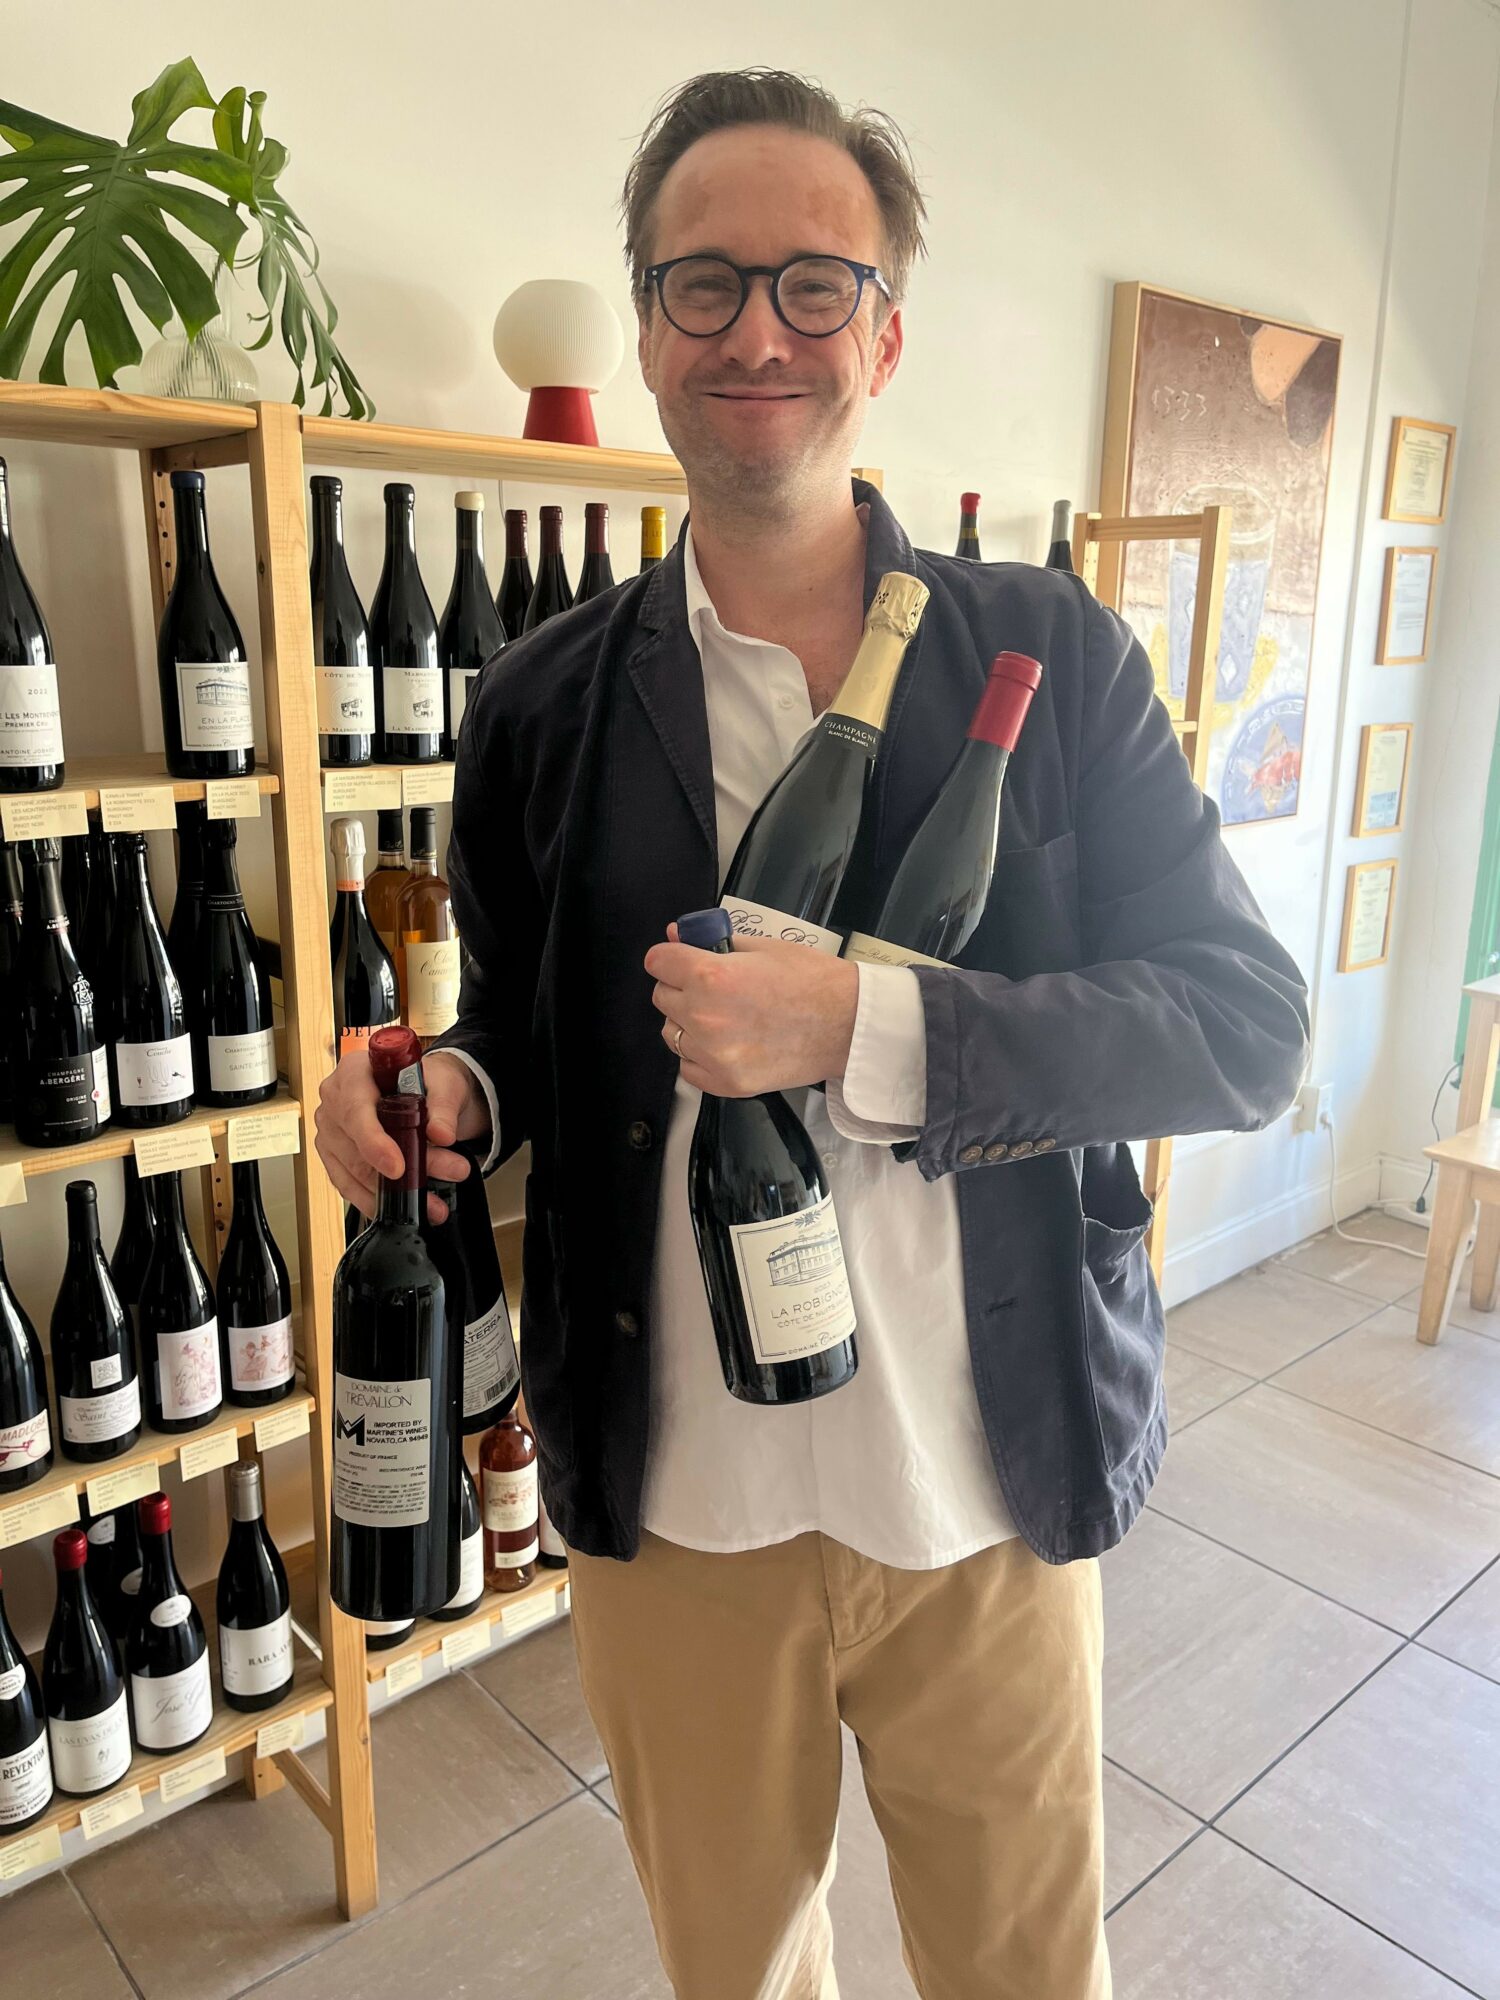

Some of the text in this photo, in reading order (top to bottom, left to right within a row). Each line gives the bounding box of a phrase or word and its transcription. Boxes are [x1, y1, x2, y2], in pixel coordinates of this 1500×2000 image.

[5, 712, 20, 720] LES
[201, 717, 215, 725] EN
[828, 730, 843, 738] BLANC
[1, 748, 30, 756] ANTOINE
[47, 1067, 85, 1077] CHAMPAGNE
[229, 1063, 252, 1072] SAINTE
[771, 1278, 847, 1319] LA ROBIGNO
[802, 1313, 814, 1322] DE
[351, 1383, 391, 1394] DOMAINE
[374, 1421, 411, 1429] IMPORTED
[405, 1426, 428, 1435] WINES
[248, 1652, 277, 1666] RARA
